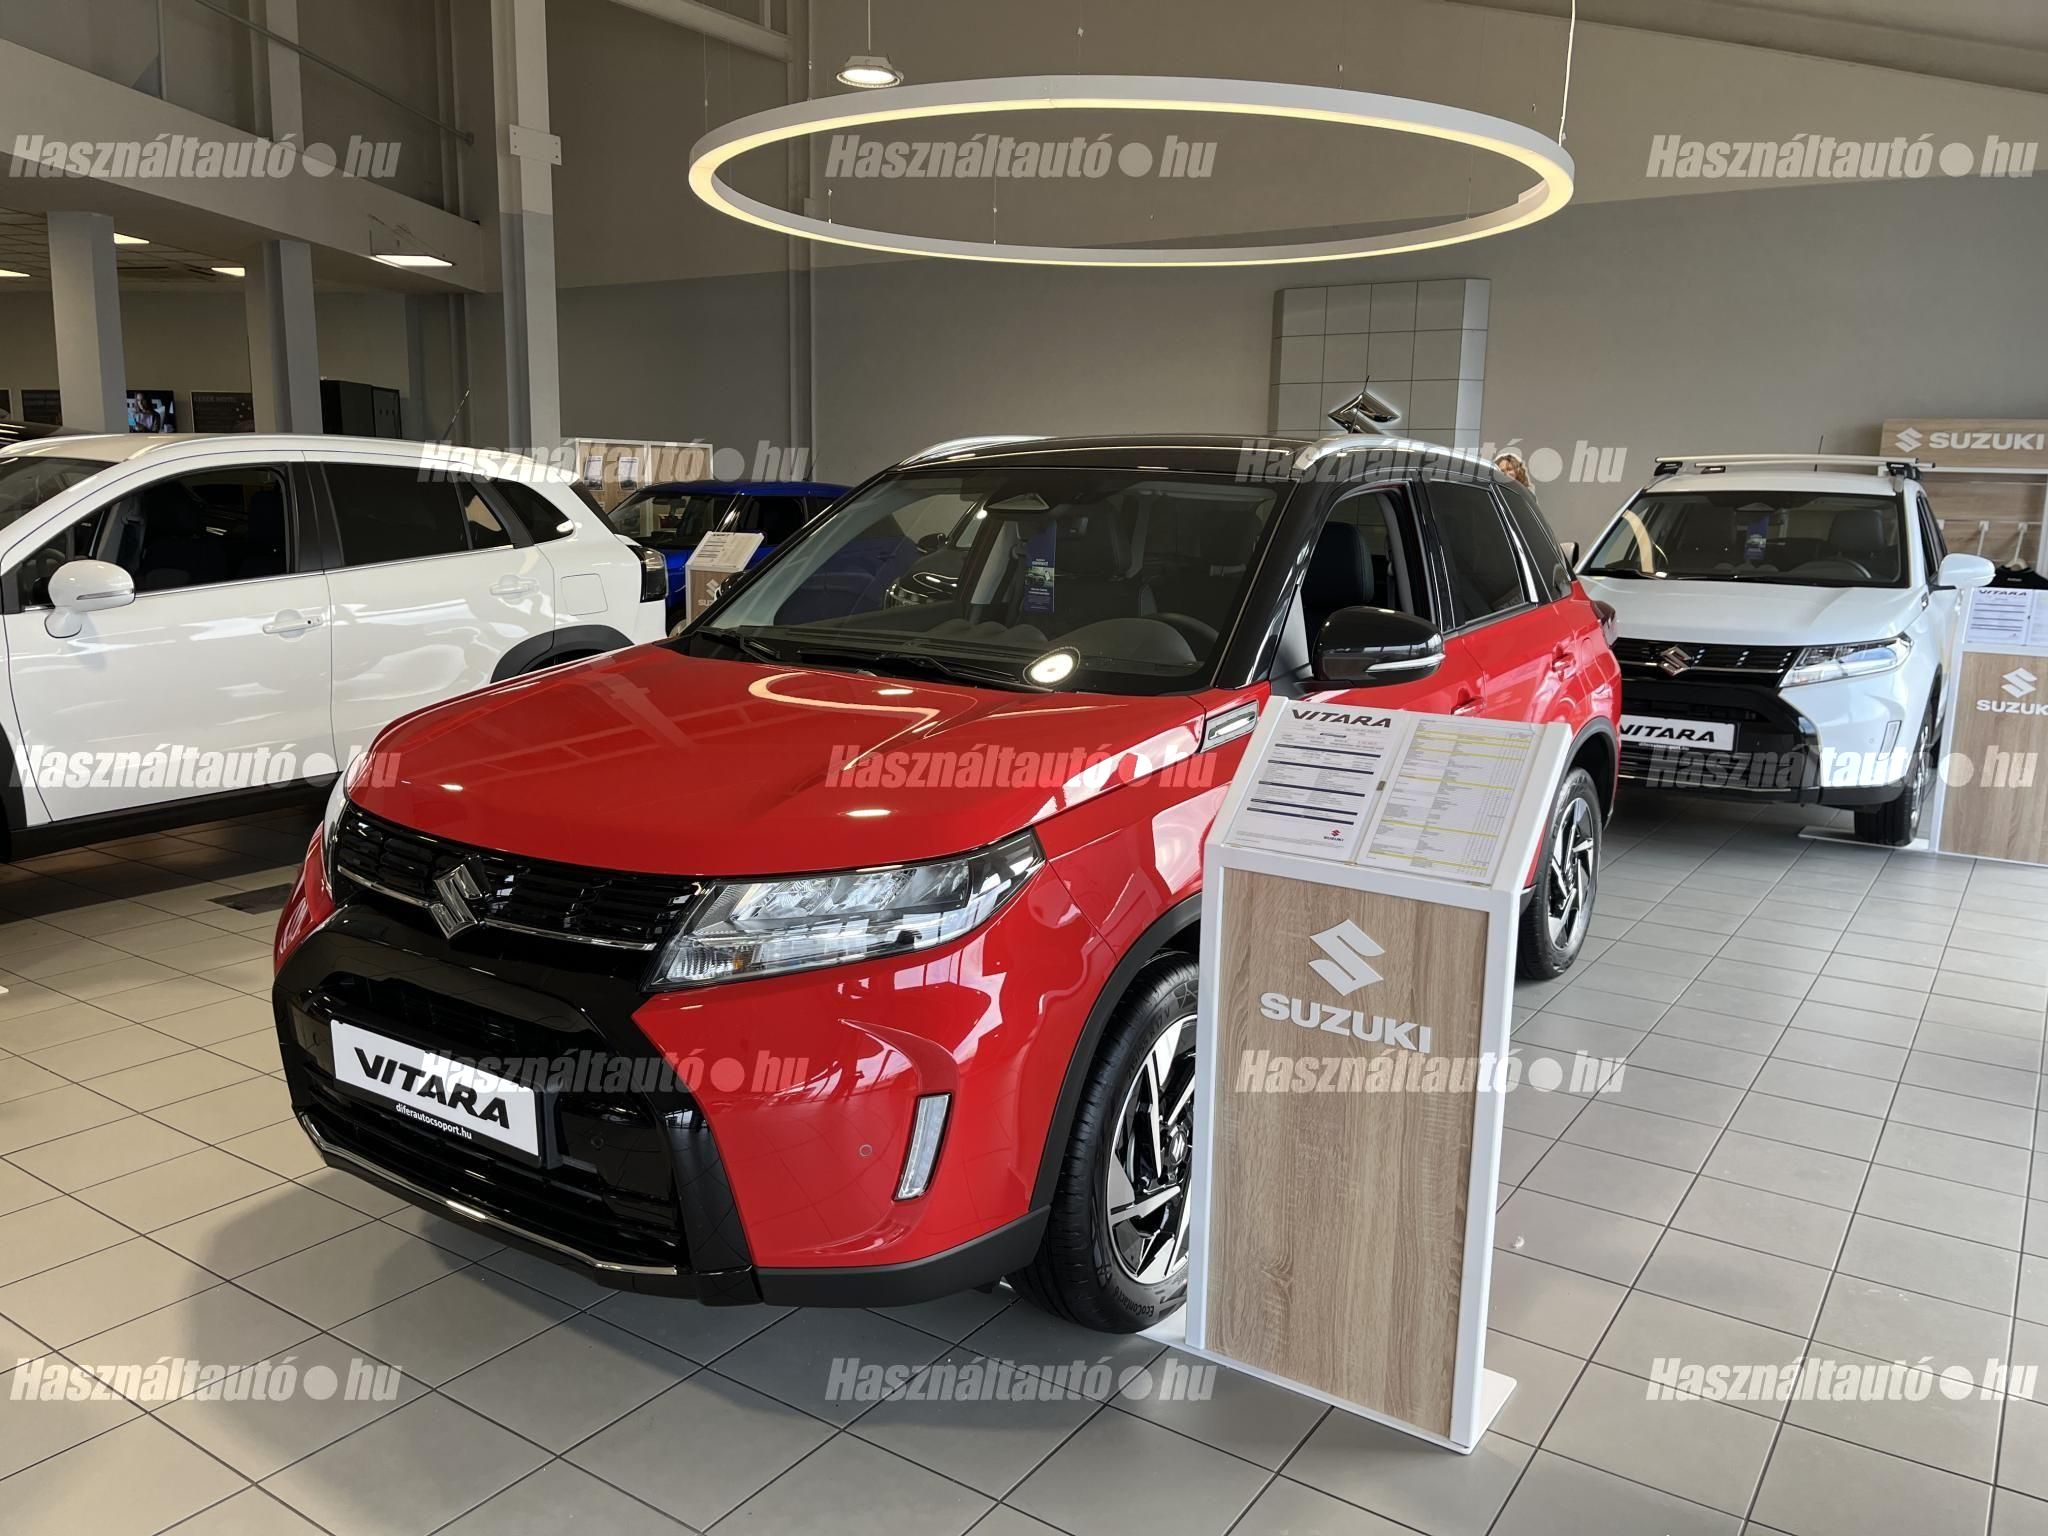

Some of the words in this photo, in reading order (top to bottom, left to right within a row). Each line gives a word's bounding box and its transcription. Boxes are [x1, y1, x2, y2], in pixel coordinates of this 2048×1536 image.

[1928, 432, 2046, 450] SUZUKI
[1976, 700, 2048, 716] SUZUK
[1292, 709, 1392, 729] VITARA
[1620, 724, 1715, 743] VITARA
[1260, 992, 1431, 1053] SUZUKI
[354, 1046, 511, 1129] VITARA
[396, 1102, 472, 1140] diferautocsoport.hu
